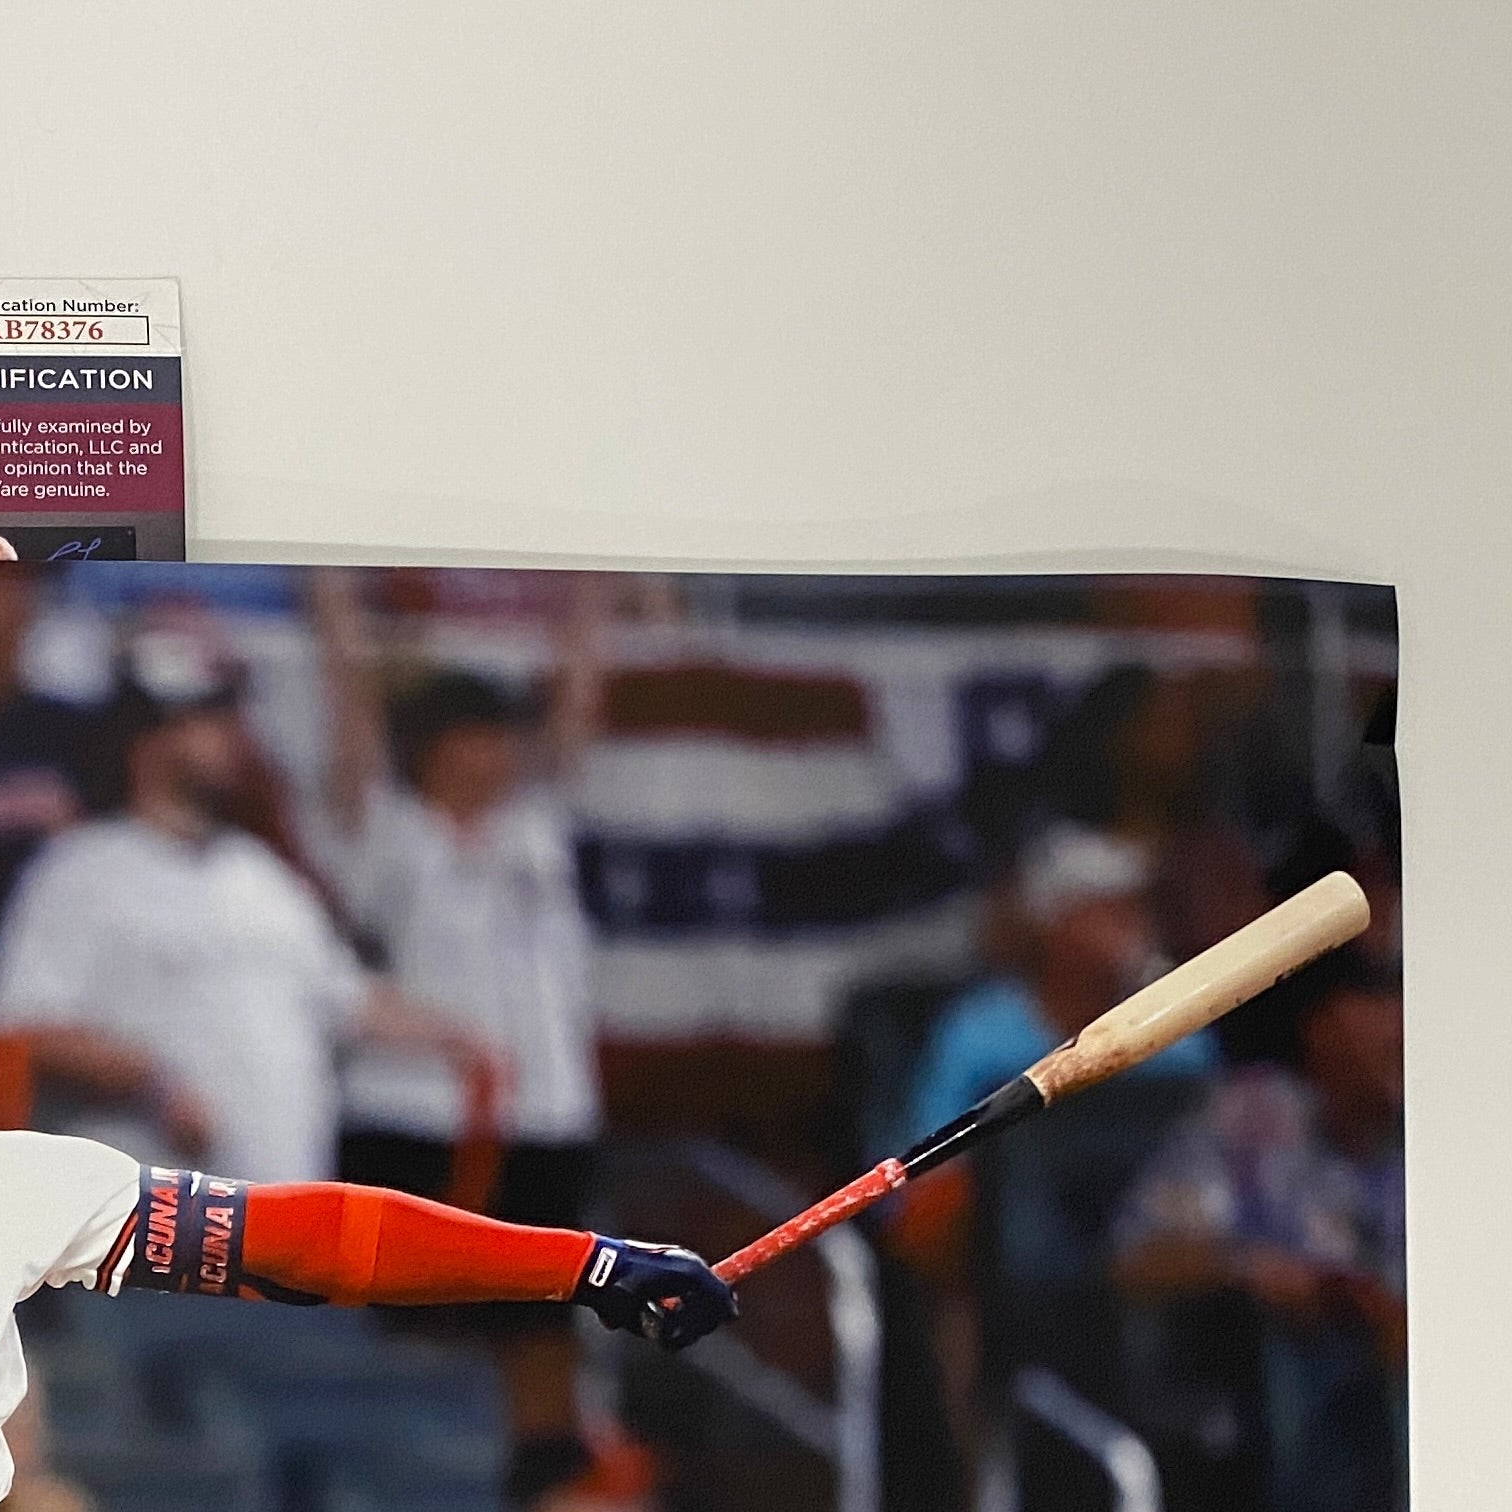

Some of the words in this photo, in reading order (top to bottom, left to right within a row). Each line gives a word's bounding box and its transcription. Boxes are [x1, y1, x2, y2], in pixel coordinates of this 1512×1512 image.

[63, 299, 140, 313] Number:
[38, 419, 124, 434] examined
[129, 419, 152, 436] by
[89, 440, 124, 455] LLC
[129, 440, 163, 455] and
[4, 461, 72, 477] opinion
[77, 461, 113, 476] that
[118, 461, 148, 476] the
[34, 482, 110, 499] genuine.
